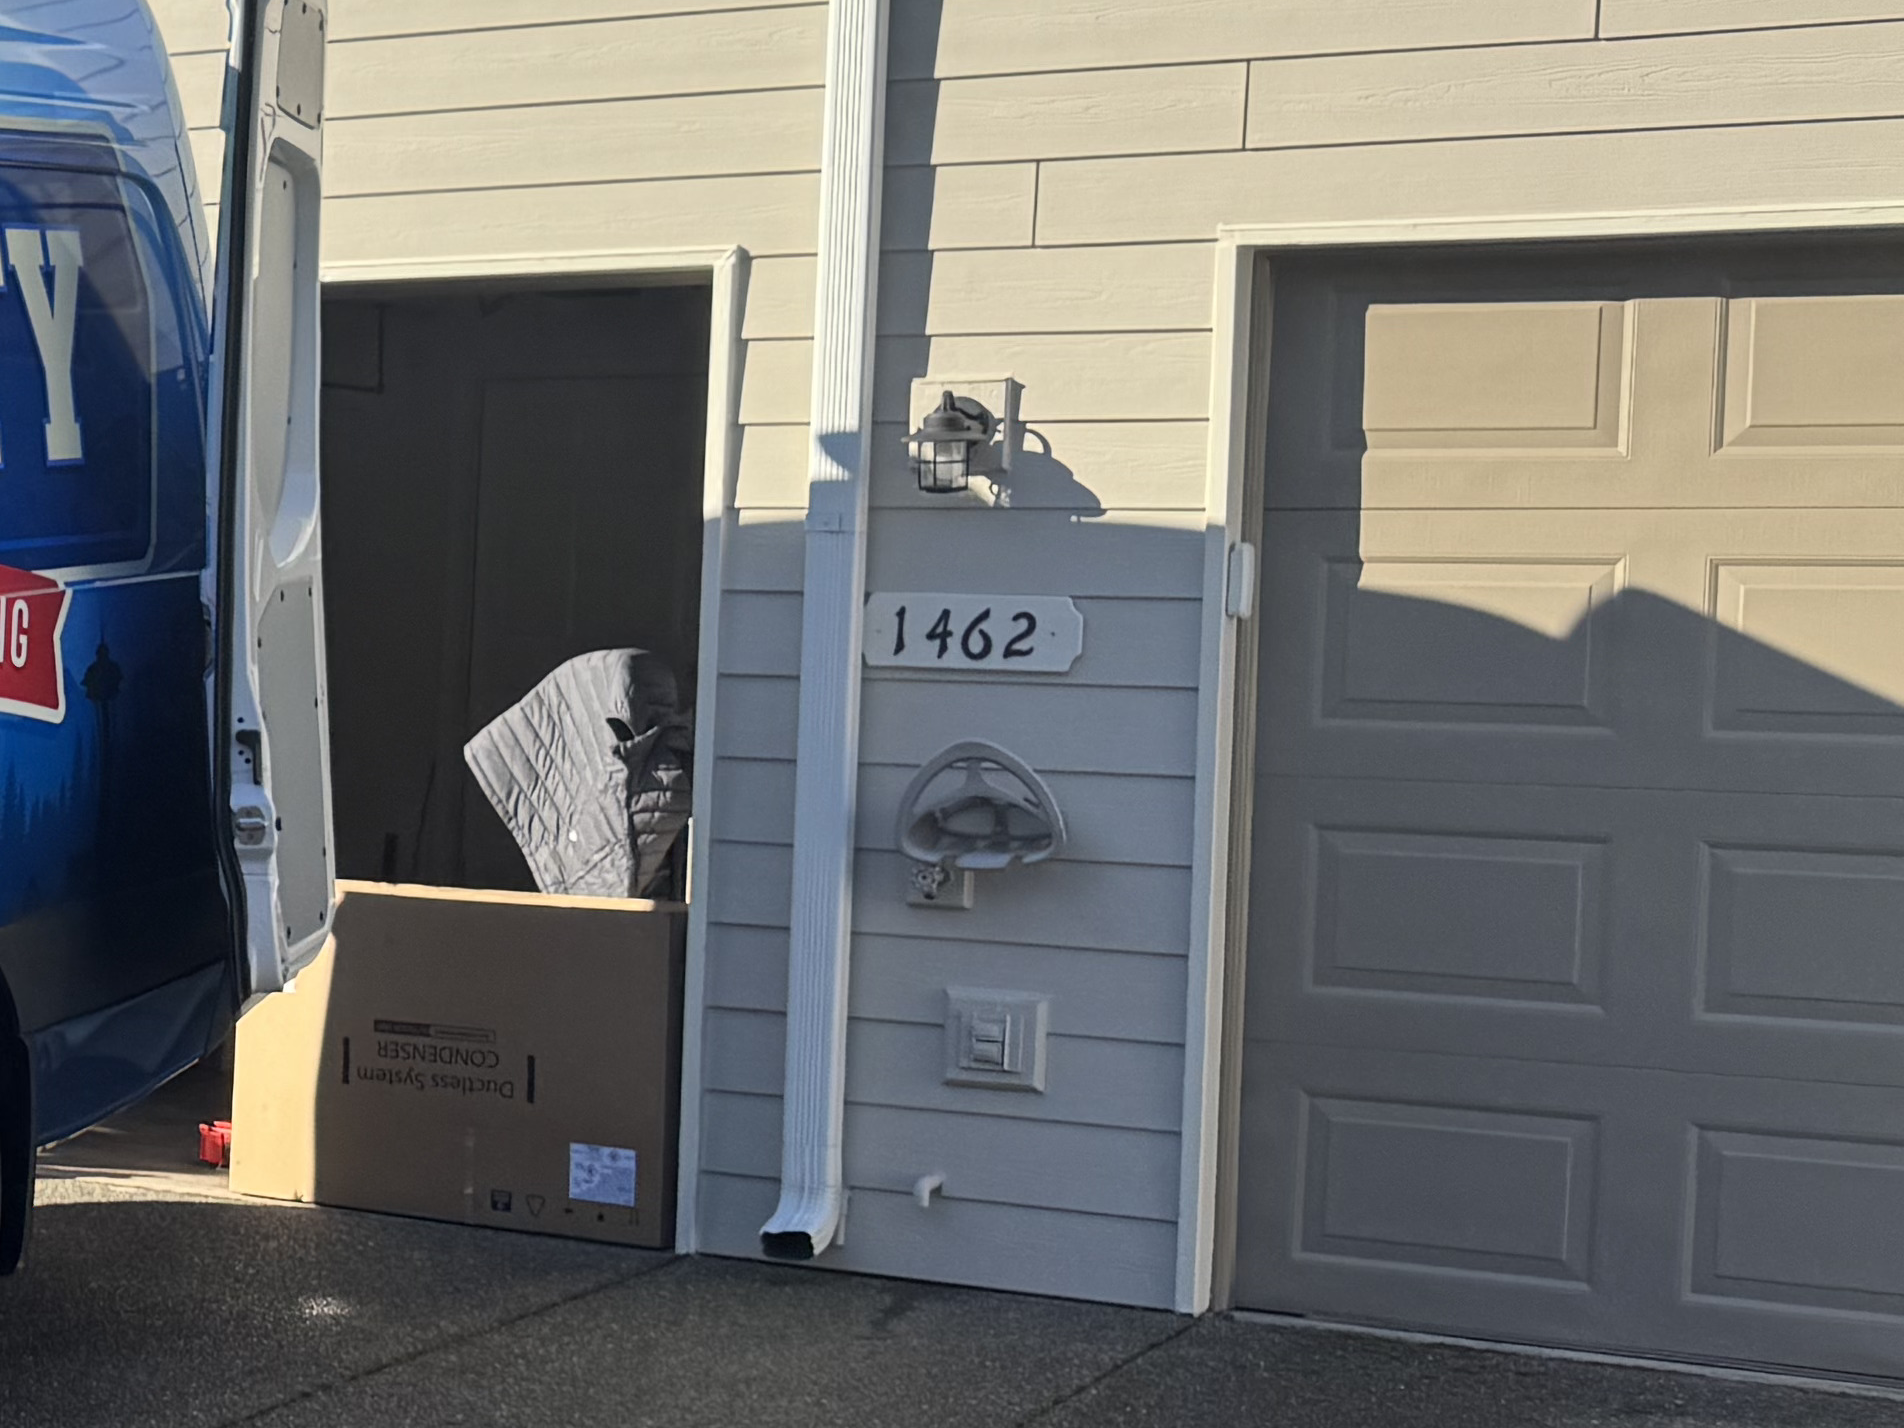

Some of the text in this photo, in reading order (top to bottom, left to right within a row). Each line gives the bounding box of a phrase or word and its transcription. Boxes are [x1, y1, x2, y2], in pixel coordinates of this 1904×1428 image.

[892, 605, 1038, 661] 1462
[376, 1042, 500, 1068] CONDENSER
[357, 1066, 515, 1099] Ductless System
